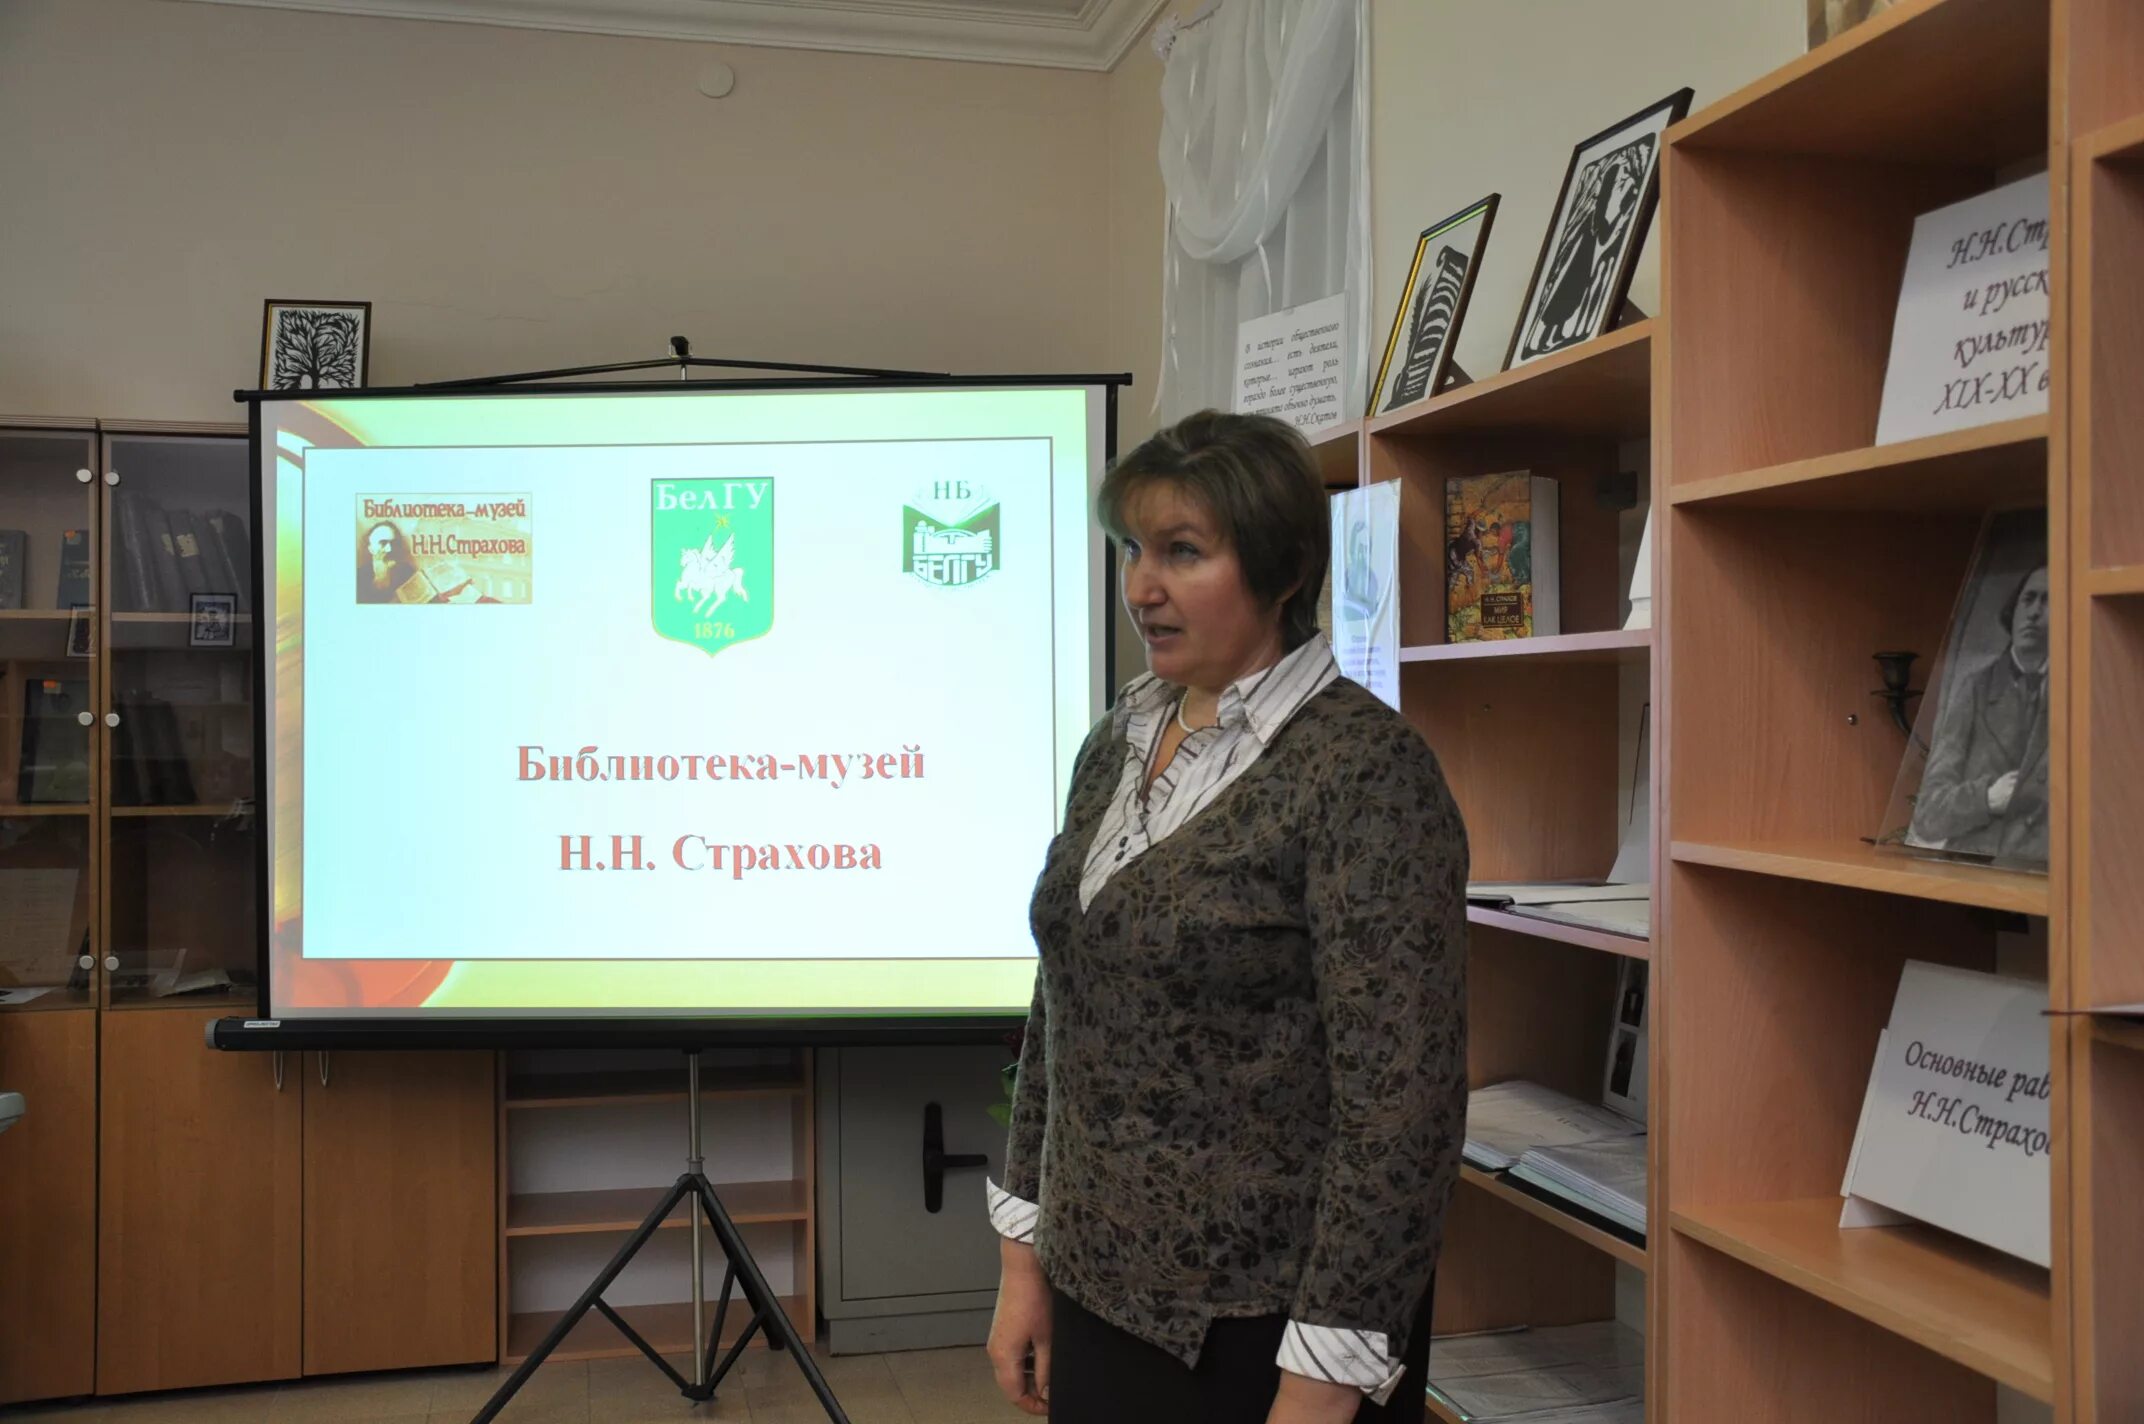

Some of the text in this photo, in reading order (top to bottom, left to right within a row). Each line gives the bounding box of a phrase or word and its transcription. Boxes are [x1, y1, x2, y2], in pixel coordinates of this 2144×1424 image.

[1963, 269, 2048, 316] и русск
[363, 498, 526, 518] Библиотека-музей
[656, 482, 768, 510] БелГУ
[694, 622, 735, 640] 1876
[515, 744, 925, 789] Библиотека-музей
[557, 834, 882, 880] Н.Н. Страхова
[1904, 1041, 2007, 1088] Основные
